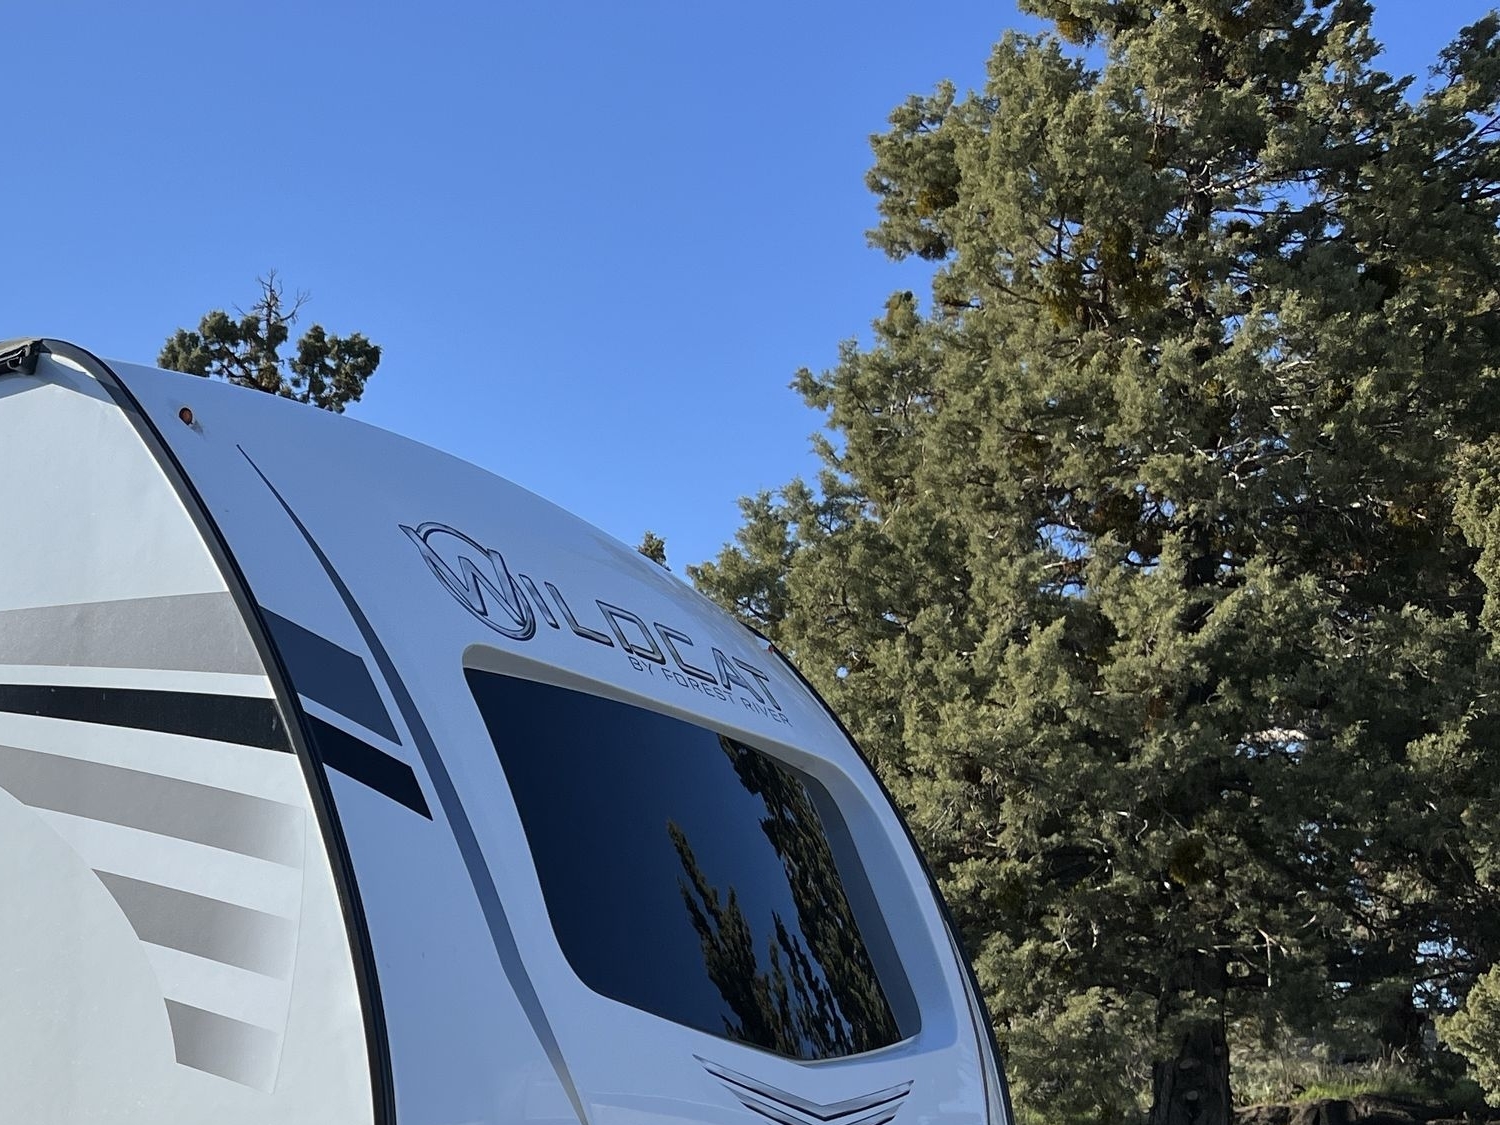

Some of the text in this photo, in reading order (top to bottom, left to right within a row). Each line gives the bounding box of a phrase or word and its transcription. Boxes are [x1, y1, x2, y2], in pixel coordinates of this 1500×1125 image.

[398, 521, 783, 711] WILDCAT
[628, 656, 792, 727] BY FOREST RIVER
